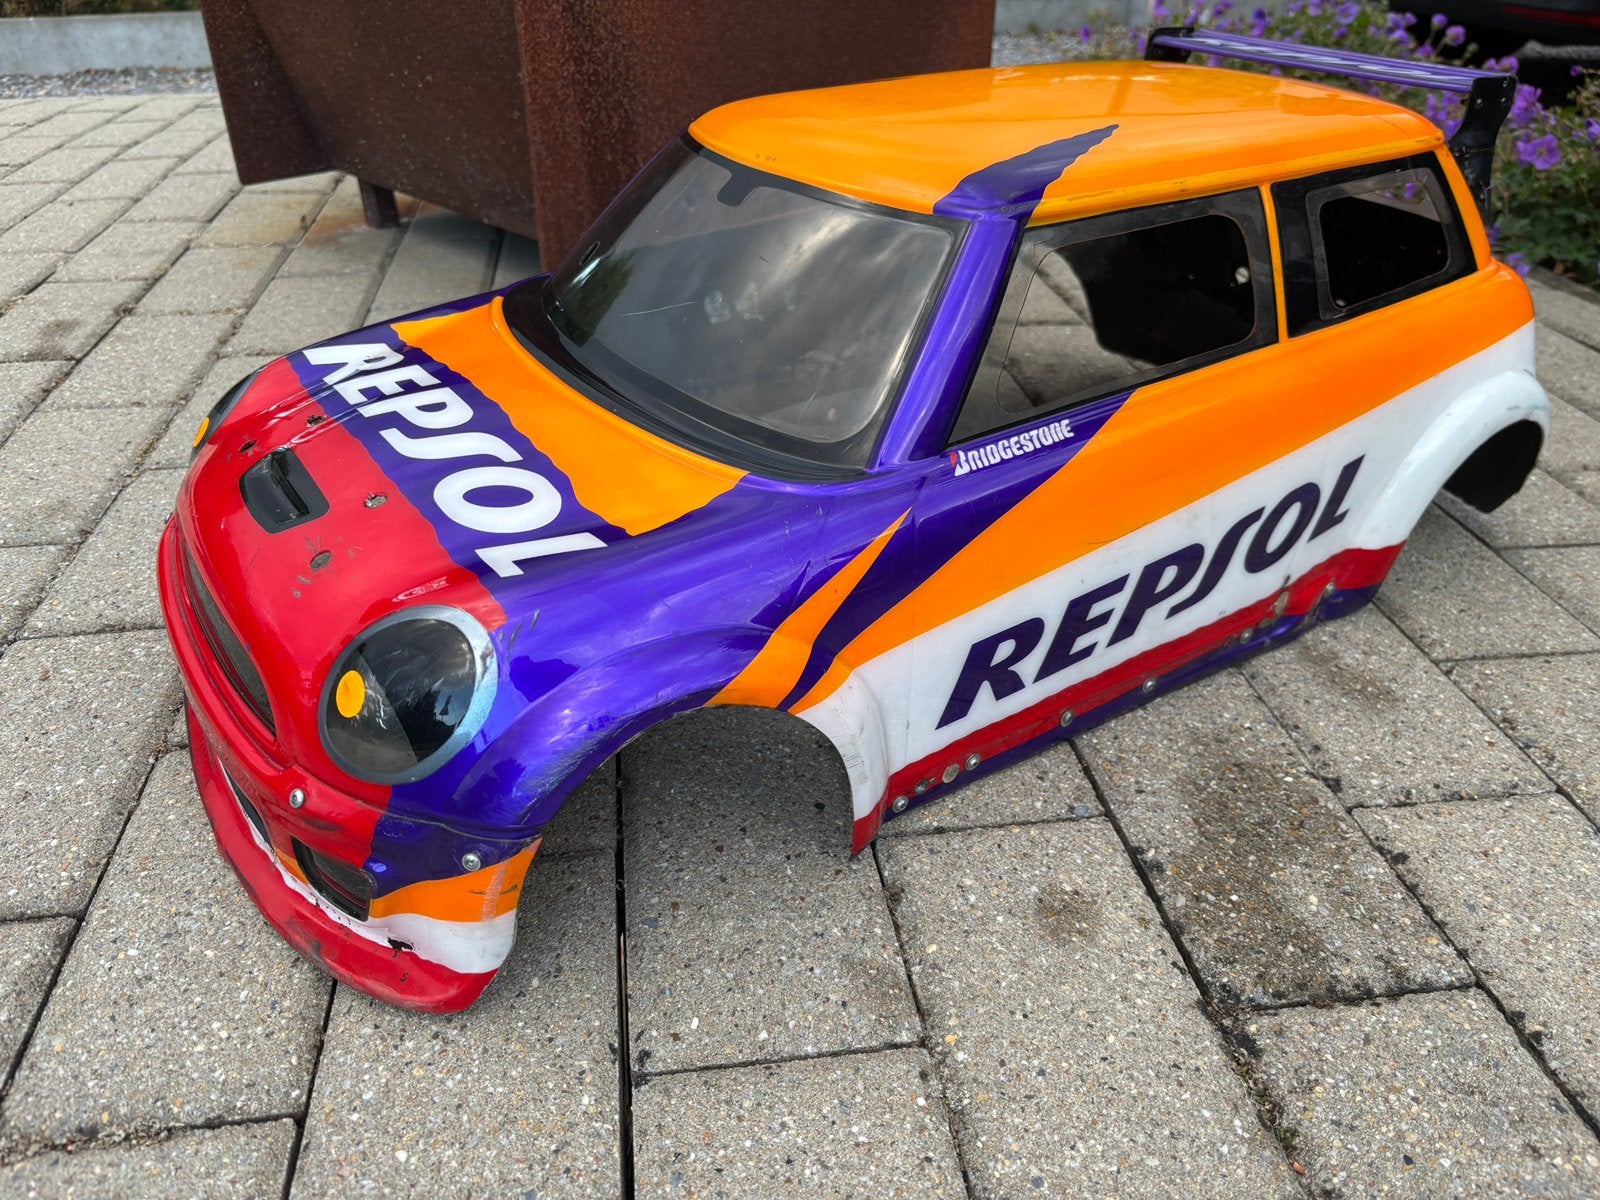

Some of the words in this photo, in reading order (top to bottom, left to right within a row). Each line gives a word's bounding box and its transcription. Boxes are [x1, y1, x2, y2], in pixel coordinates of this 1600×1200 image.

[302, 343, 608, 577] REPSOL
[950, 419, 1074, 476] BRIDGESTONE
[935, 454, 1366, 730] REPSOL
